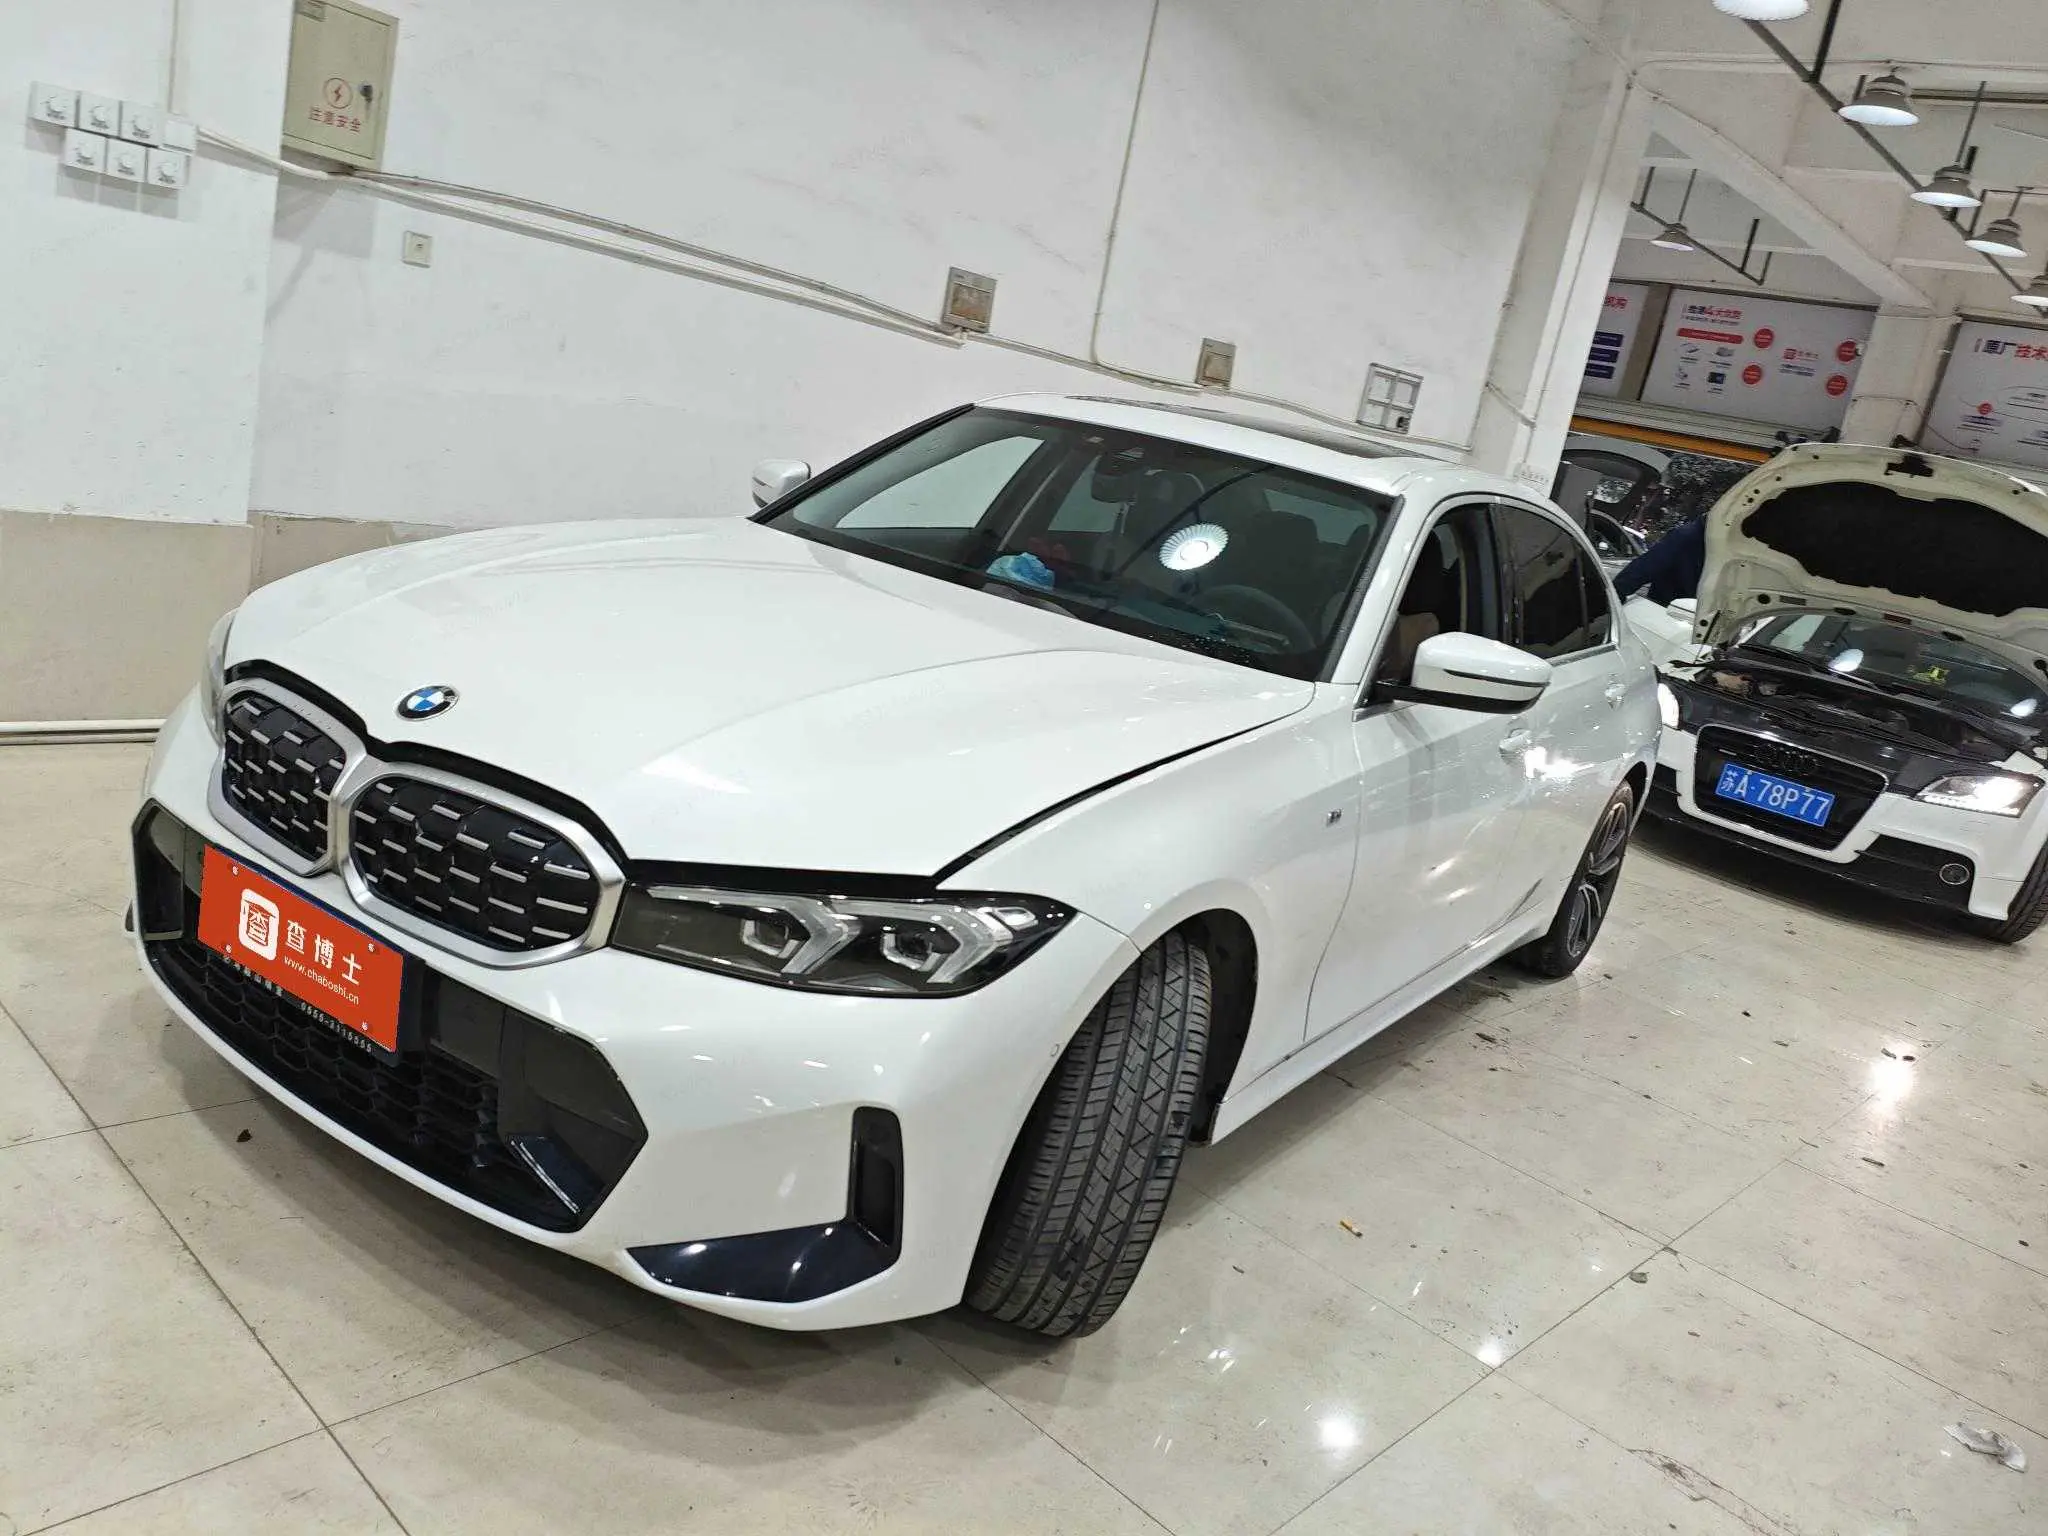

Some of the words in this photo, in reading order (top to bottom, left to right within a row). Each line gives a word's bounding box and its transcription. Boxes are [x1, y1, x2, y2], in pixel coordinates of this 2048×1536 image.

[308, 106, 361, 133] 注意安全
[285, 919, 363, 985] 查博士
[283, 955, 360, 1006] www.chaboshi.cn
